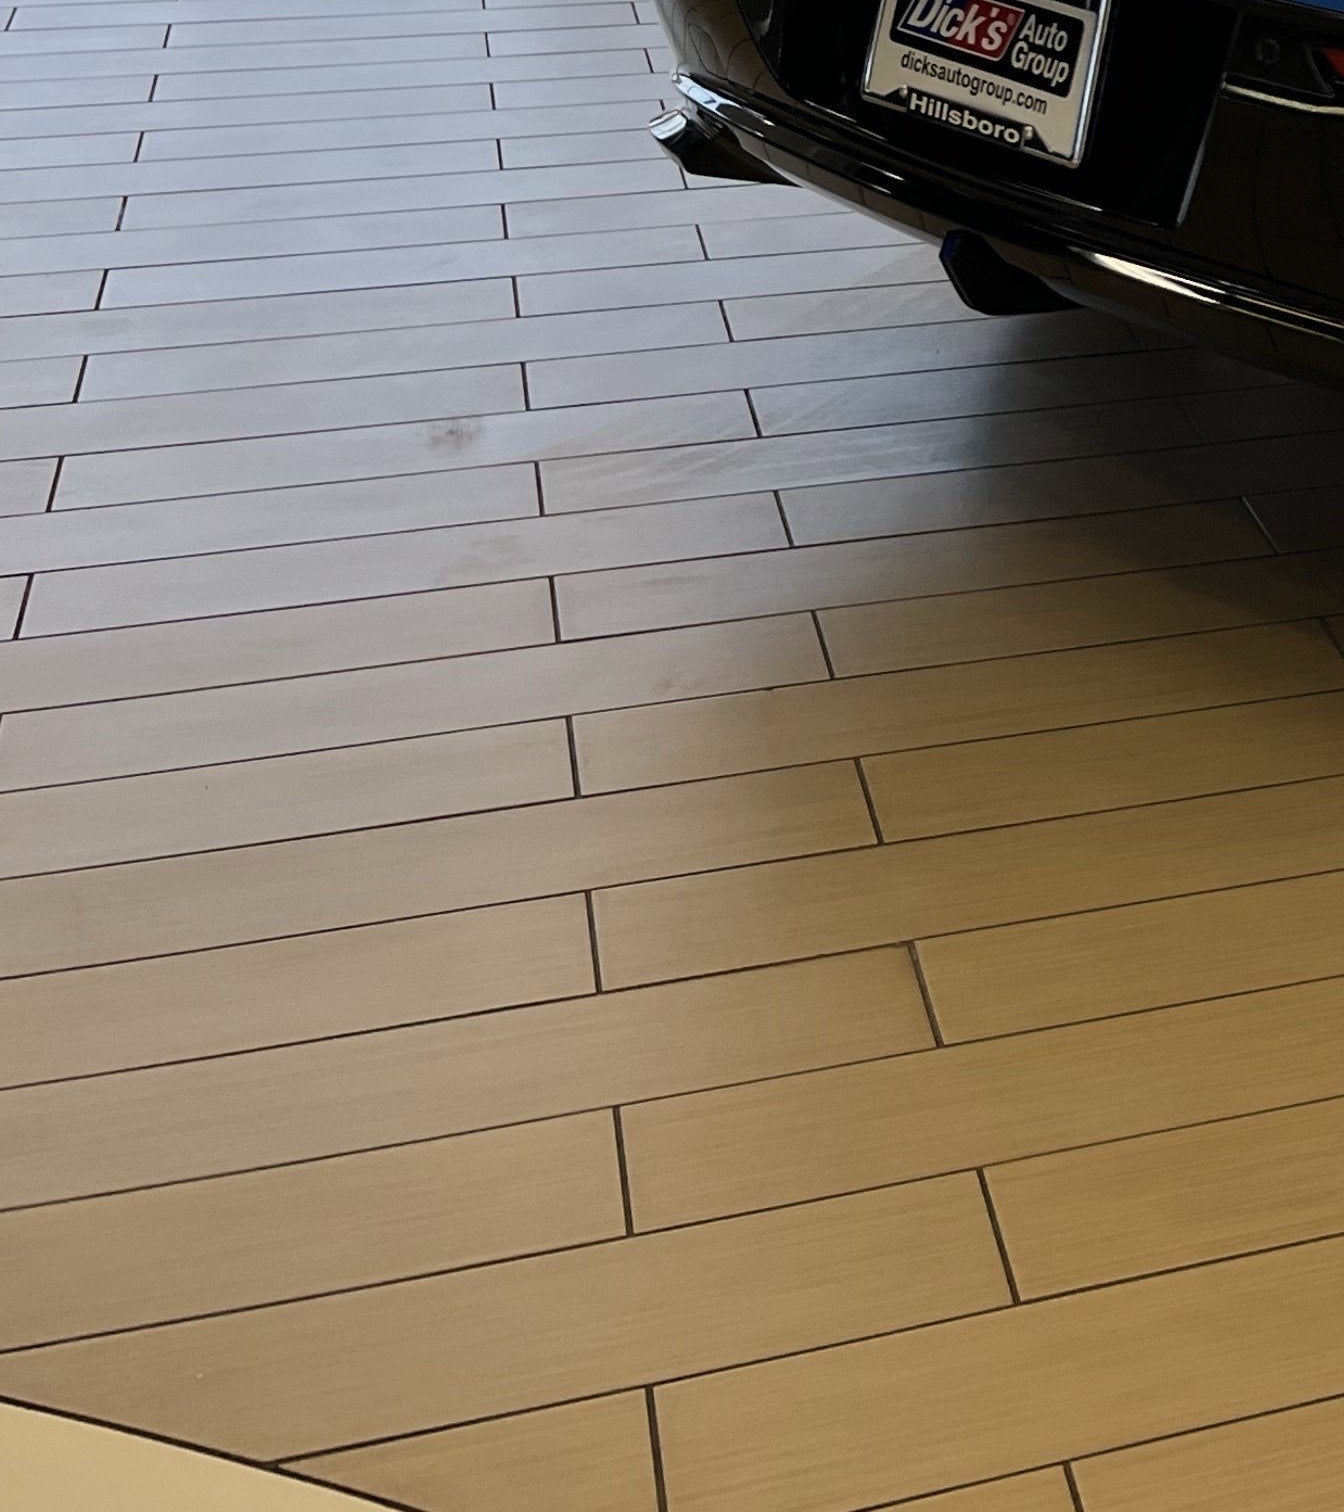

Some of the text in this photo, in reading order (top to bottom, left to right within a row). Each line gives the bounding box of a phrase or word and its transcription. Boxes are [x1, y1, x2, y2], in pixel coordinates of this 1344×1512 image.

[1018, 14, 1069, 52] Auto
[900, 50, 1049, 115] dicksautogroup.com
[1010, 41, 1070, 88] Group
[908, 93, 1021, 144] Hillsboro
